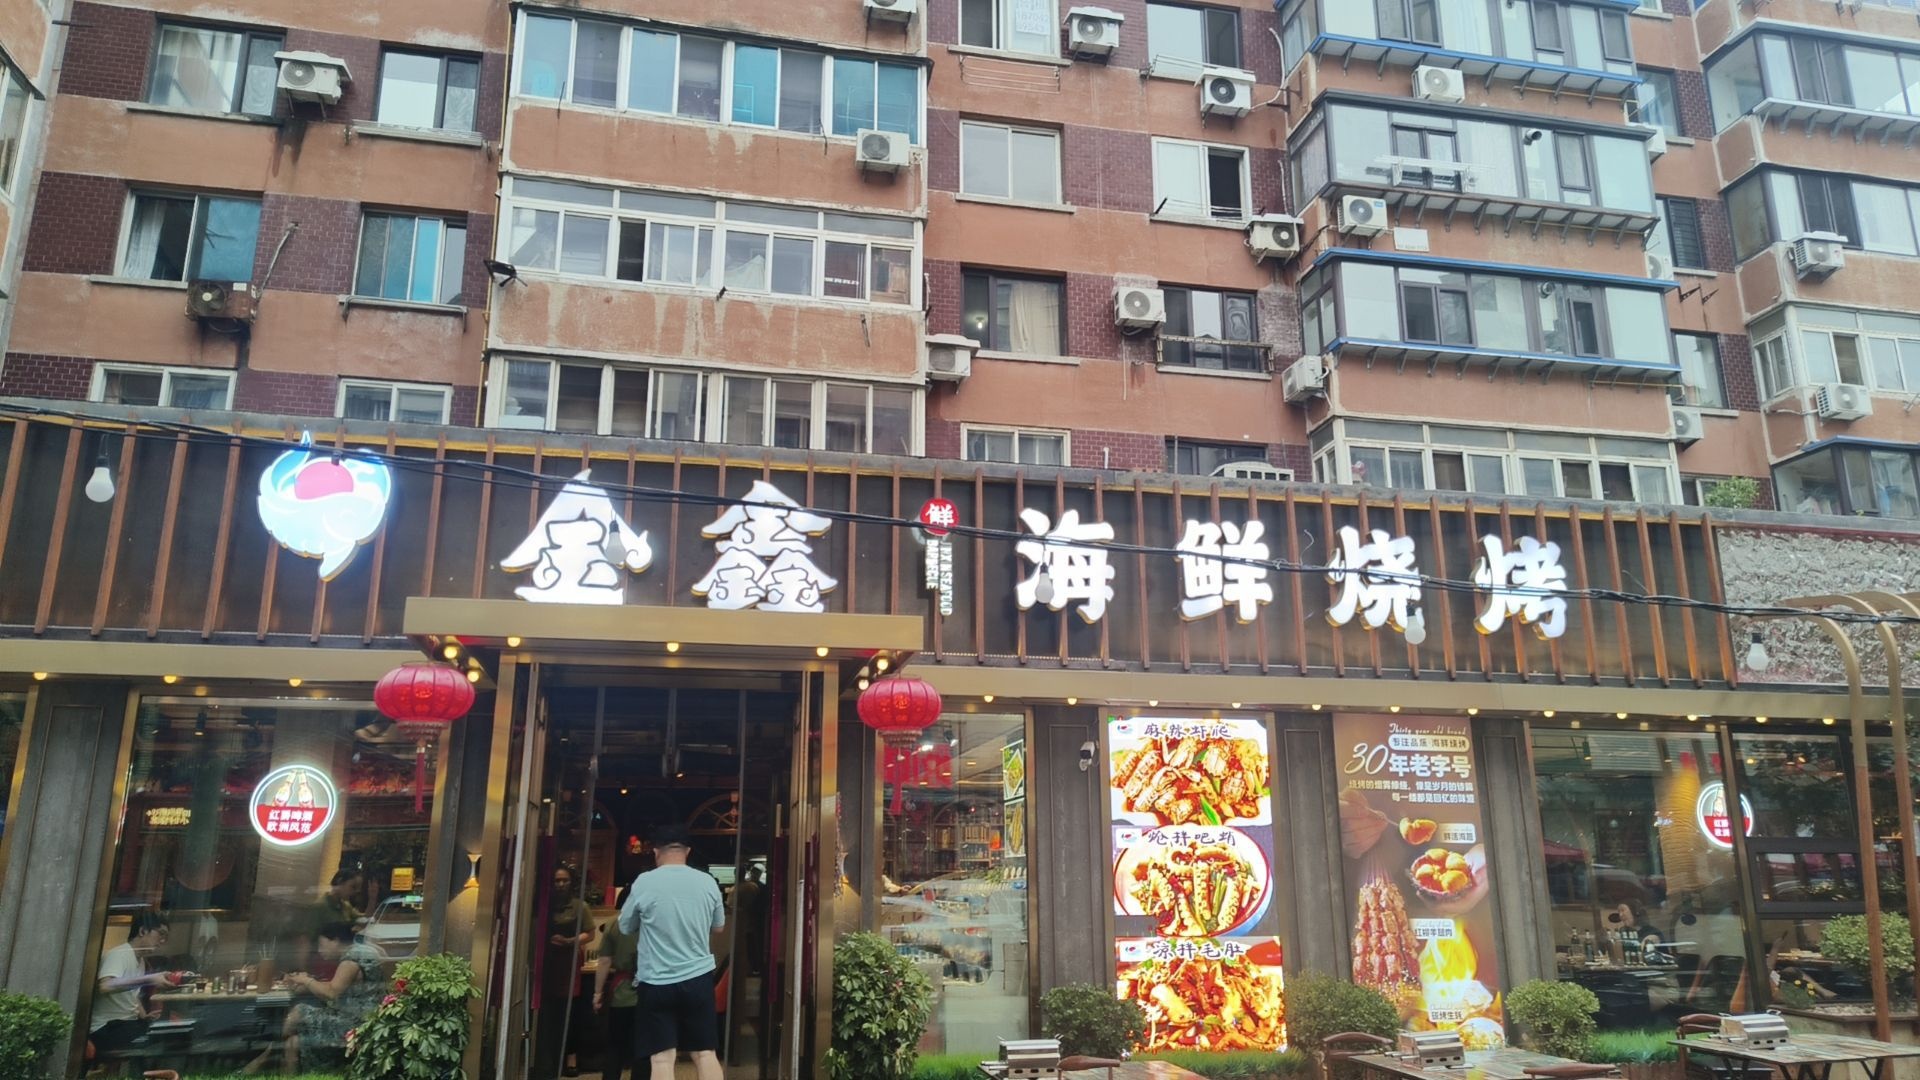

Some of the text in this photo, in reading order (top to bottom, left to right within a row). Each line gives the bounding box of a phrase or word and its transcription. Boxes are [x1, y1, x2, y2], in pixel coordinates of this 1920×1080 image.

[926, 503, 955, 526] 鲜
[1015, 507, 1568, 641] 海鲜烧烤
[1144, 723, 1232, 739] 麻辣虾爬
[267, 822, 311, 833] 欧洲风范
